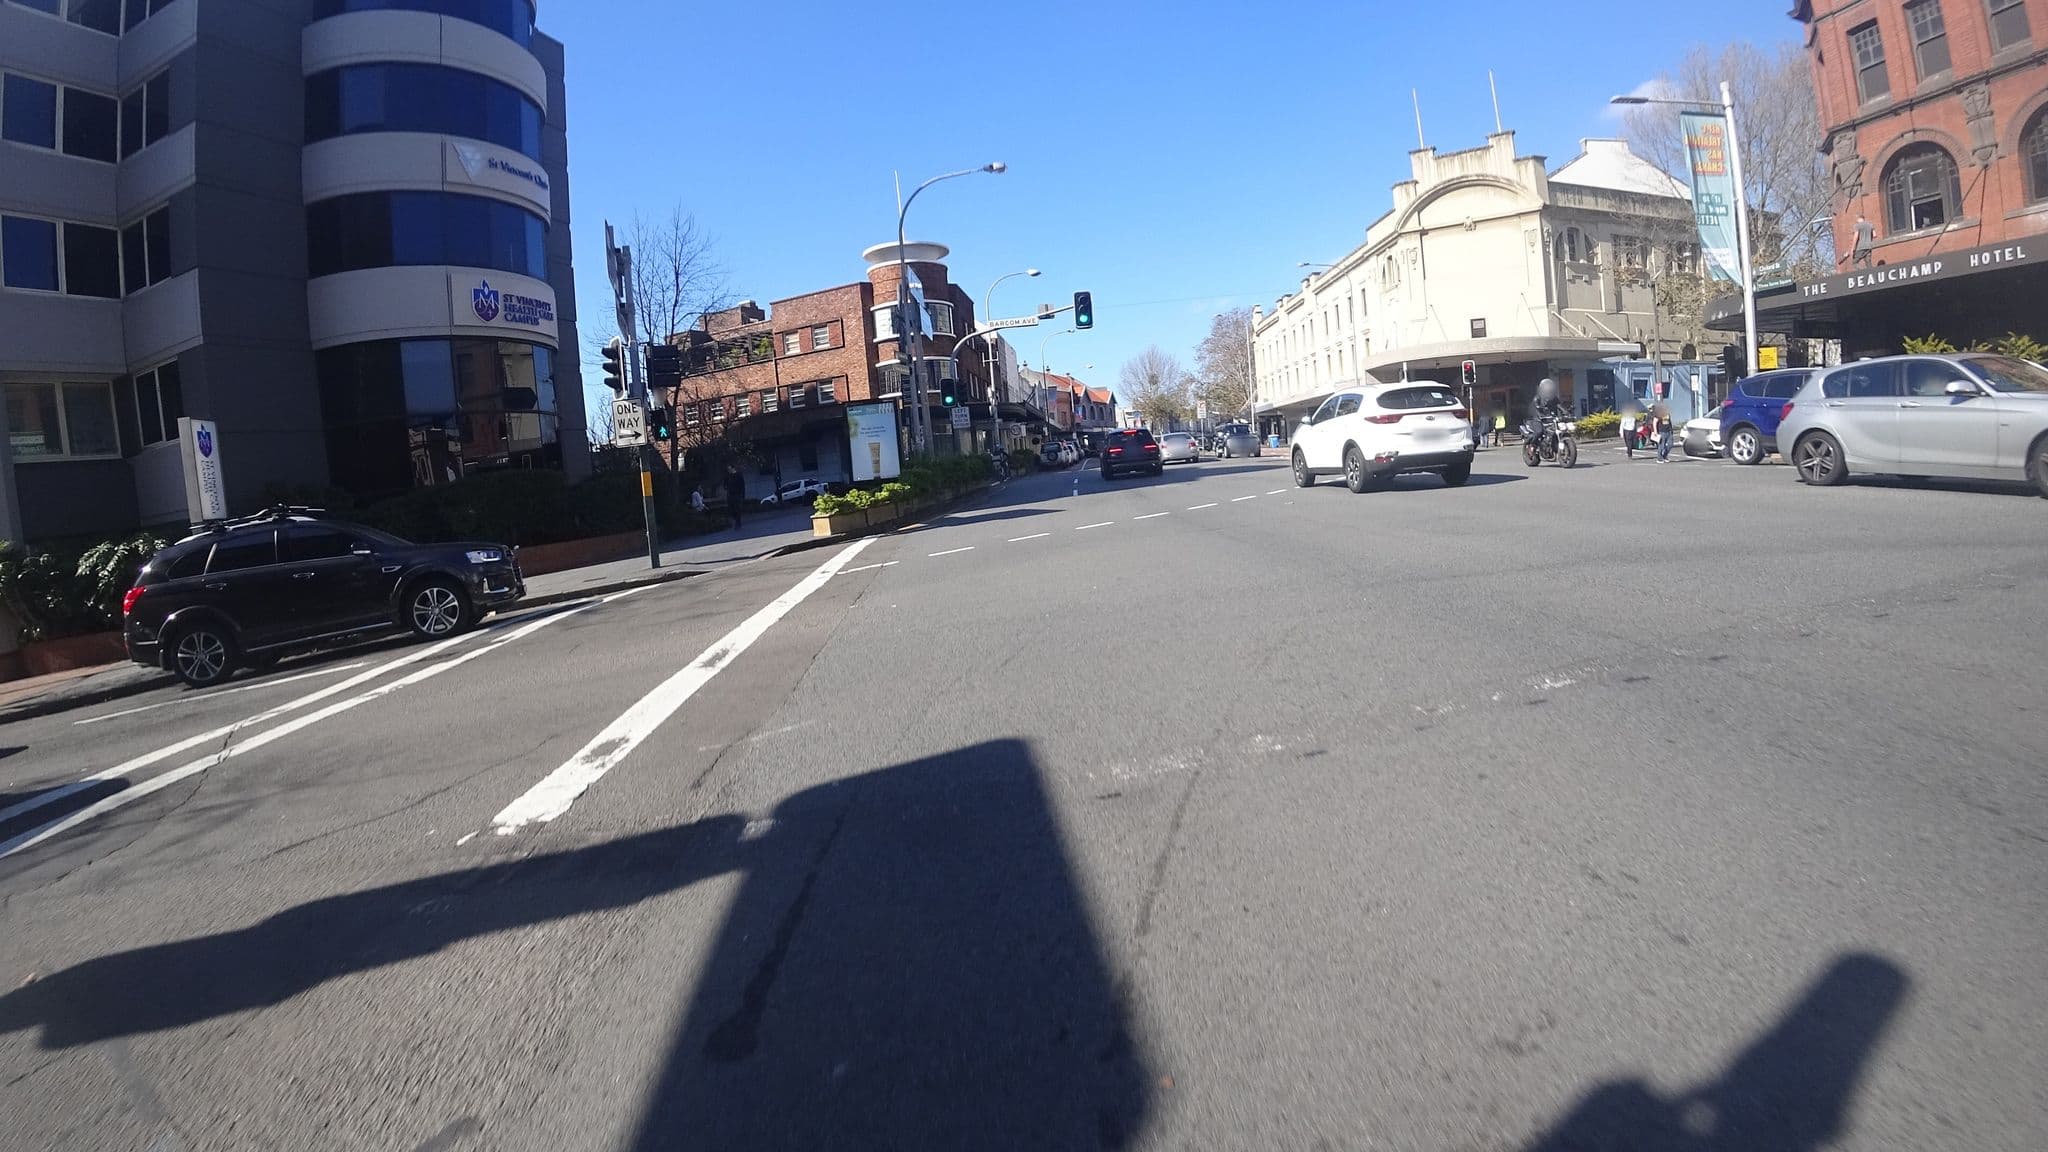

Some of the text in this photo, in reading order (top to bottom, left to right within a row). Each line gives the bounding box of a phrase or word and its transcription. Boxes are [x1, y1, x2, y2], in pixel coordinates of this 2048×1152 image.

[1803, 246, 2026, 296] THE BEAUCHAMP HOTEL
[503, 293, 514, 303] ST
[503, 303, 538, 316] HEALTH
[504, 312, 540, 326] CAMPUS
[989, 317, 1036, 327] BARCOM AVE
[616, 402, 639, 415] ONE
[617, 416, 640, 429] WAY
